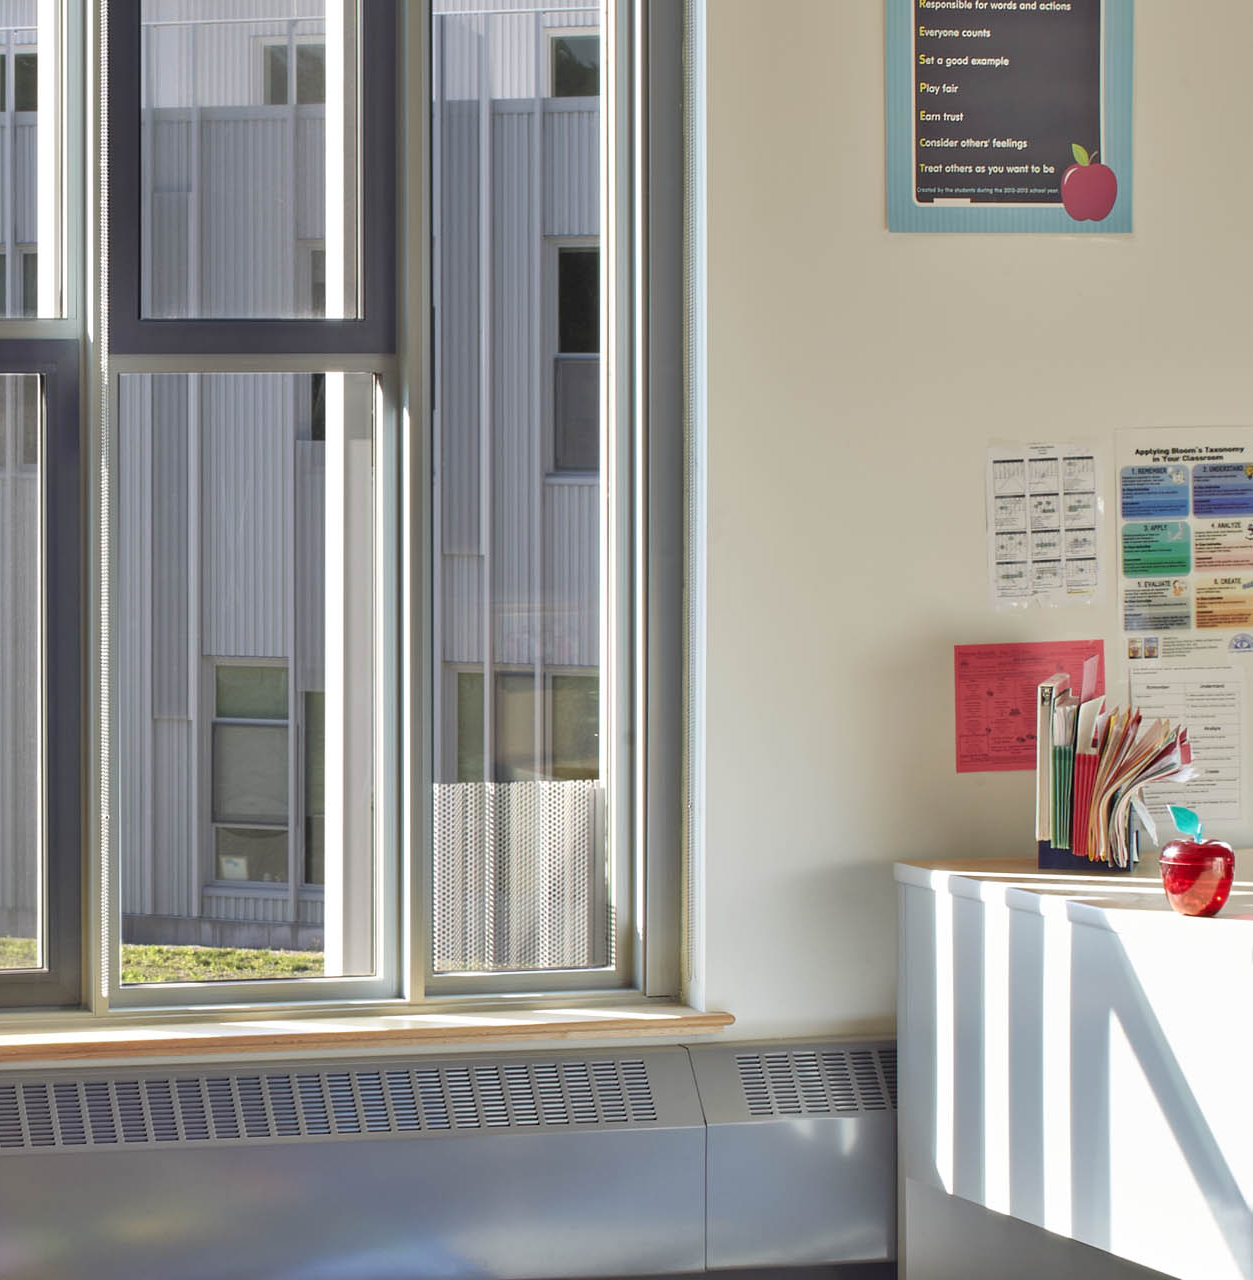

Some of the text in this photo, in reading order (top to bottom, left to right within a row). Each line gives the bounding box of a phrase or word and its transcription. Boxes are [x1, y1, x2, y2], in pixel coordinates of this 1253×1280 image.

[975, 0, 988, 10] for
[990, 1, 1017, 10] words
[1019, 1, 1037, 10] and
[1039, 1, 1071, 11] actions
[919, 26, 991, 39] Everyone counts
[919, 54, 1010, 67] Set a good example
[919, 82, 959, 95] Play fair
[920, 110, 964, 122] Earn trust
[919, 138, 1028, 150] Consider others' feelings
[919, 163, 1055, 175] Treat others as you want to be
[1134, 448, 1170, 456] Applying
[1171, 446, 1203, 454] Bloom's
[1144, 580, 1171, 588] EVALUATE
